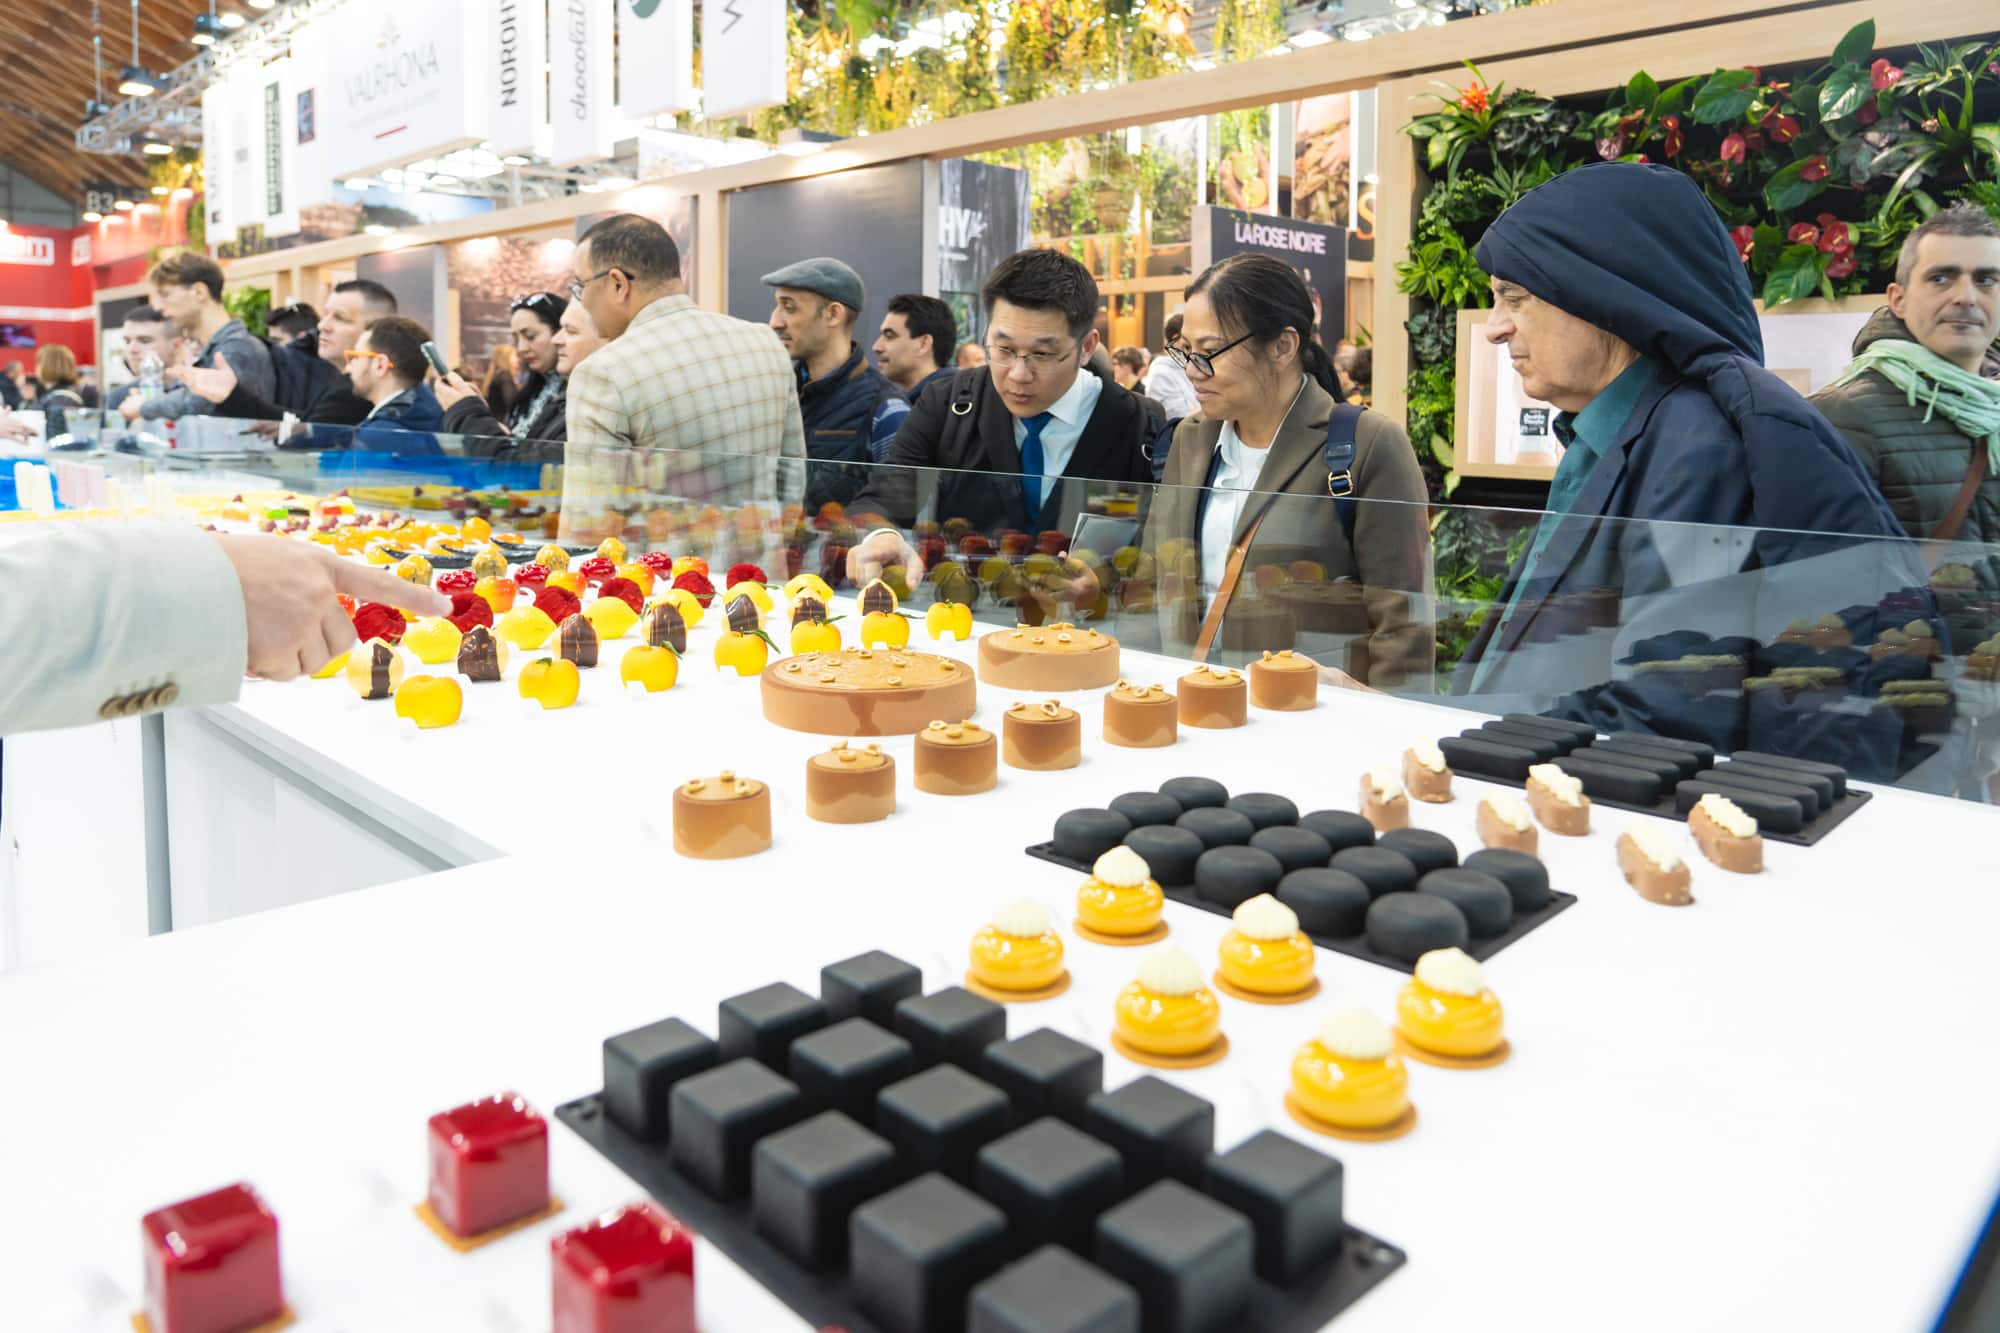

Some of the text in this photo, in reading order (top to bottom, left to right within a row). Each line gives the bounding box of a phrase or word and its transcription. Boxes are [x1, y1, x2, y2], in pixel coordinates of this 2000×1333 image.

[500, 0, 517, 107] NOROH
[566, 0, 585, 120] chocolat
[1234, 221, 1326, 254] LA ROSE NOIRE
